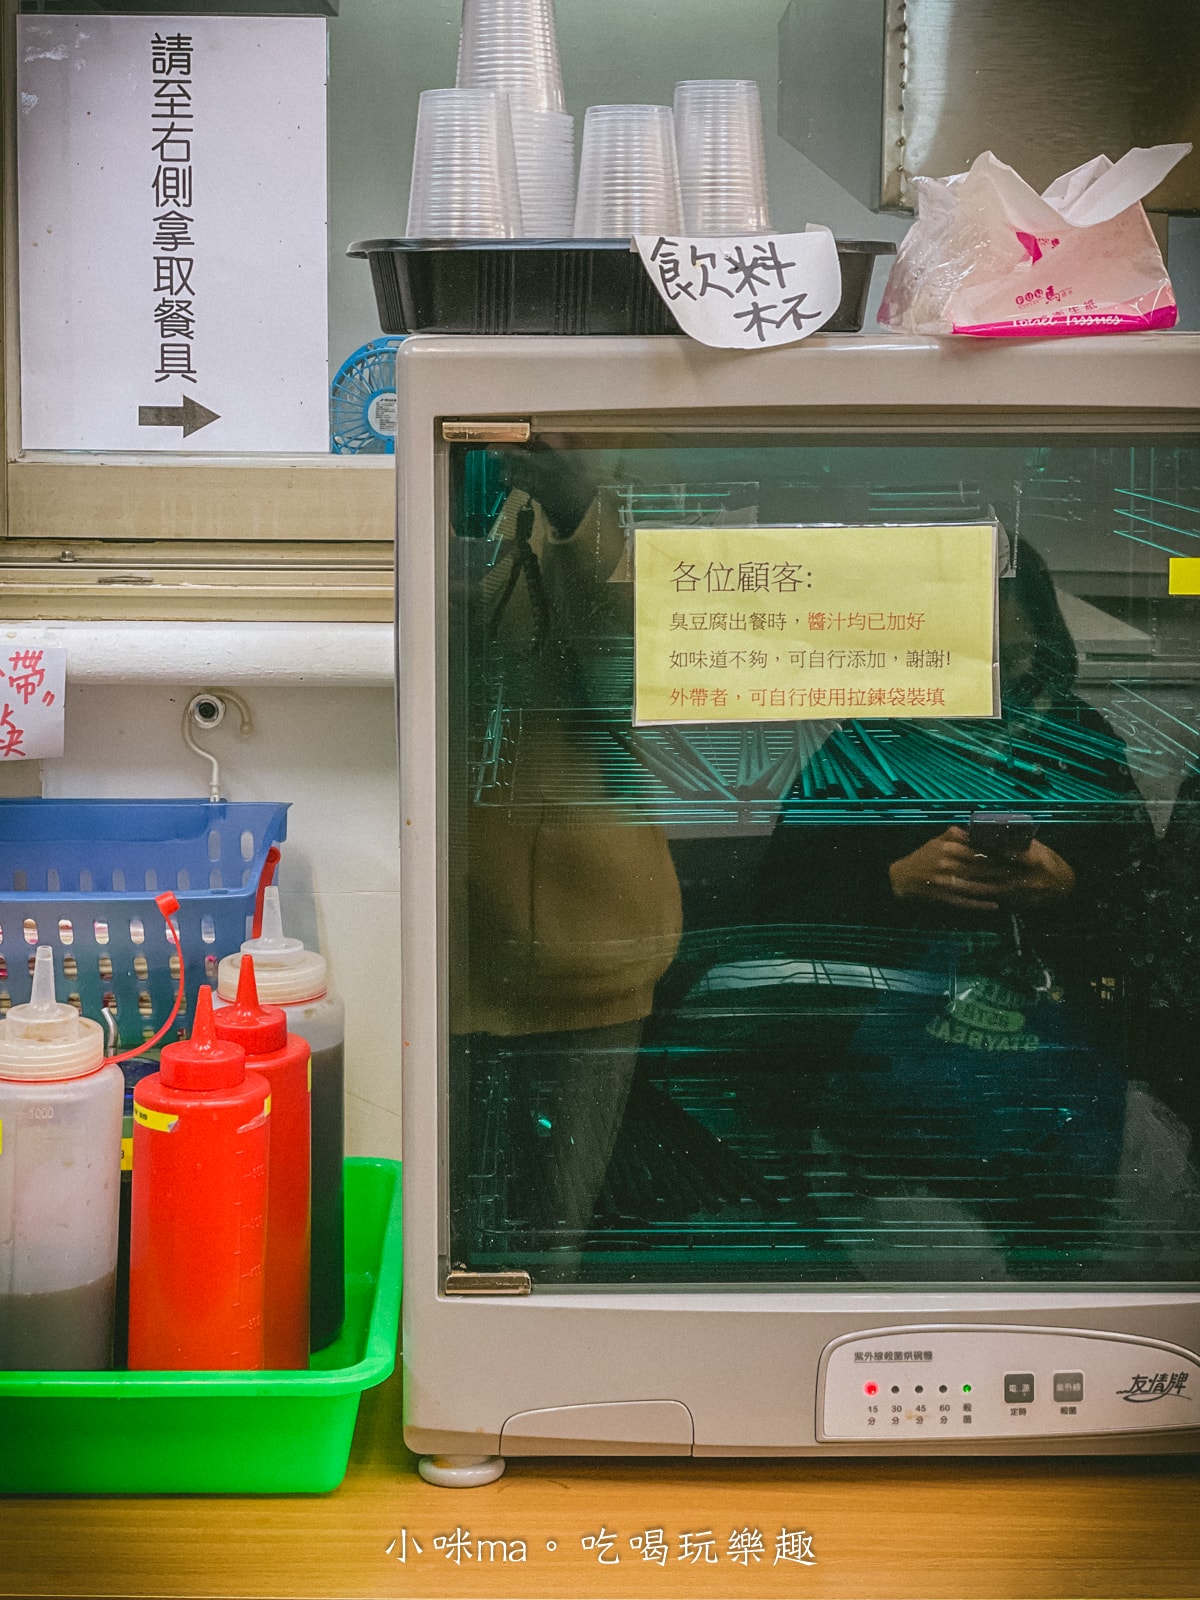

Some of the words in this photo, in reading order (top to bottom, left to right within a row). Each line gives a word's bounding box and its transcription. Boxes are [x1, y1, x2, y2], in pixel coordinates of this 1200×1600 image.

[151, 32, 197, 383] 請至右側拿取餐具
[650, 236, 796, 301] 飲料
[733, 293, 823, 342] 杯
[891, 1405, 902, 1413] 30
[939, 1404, 950, 1412] 60
[867, 1417, 875, 1425] 分
[891, 1416, 899, 1424] 分
[916, 1416, 924, 1424] 分
[940, 1416, 948, 1424] 分
